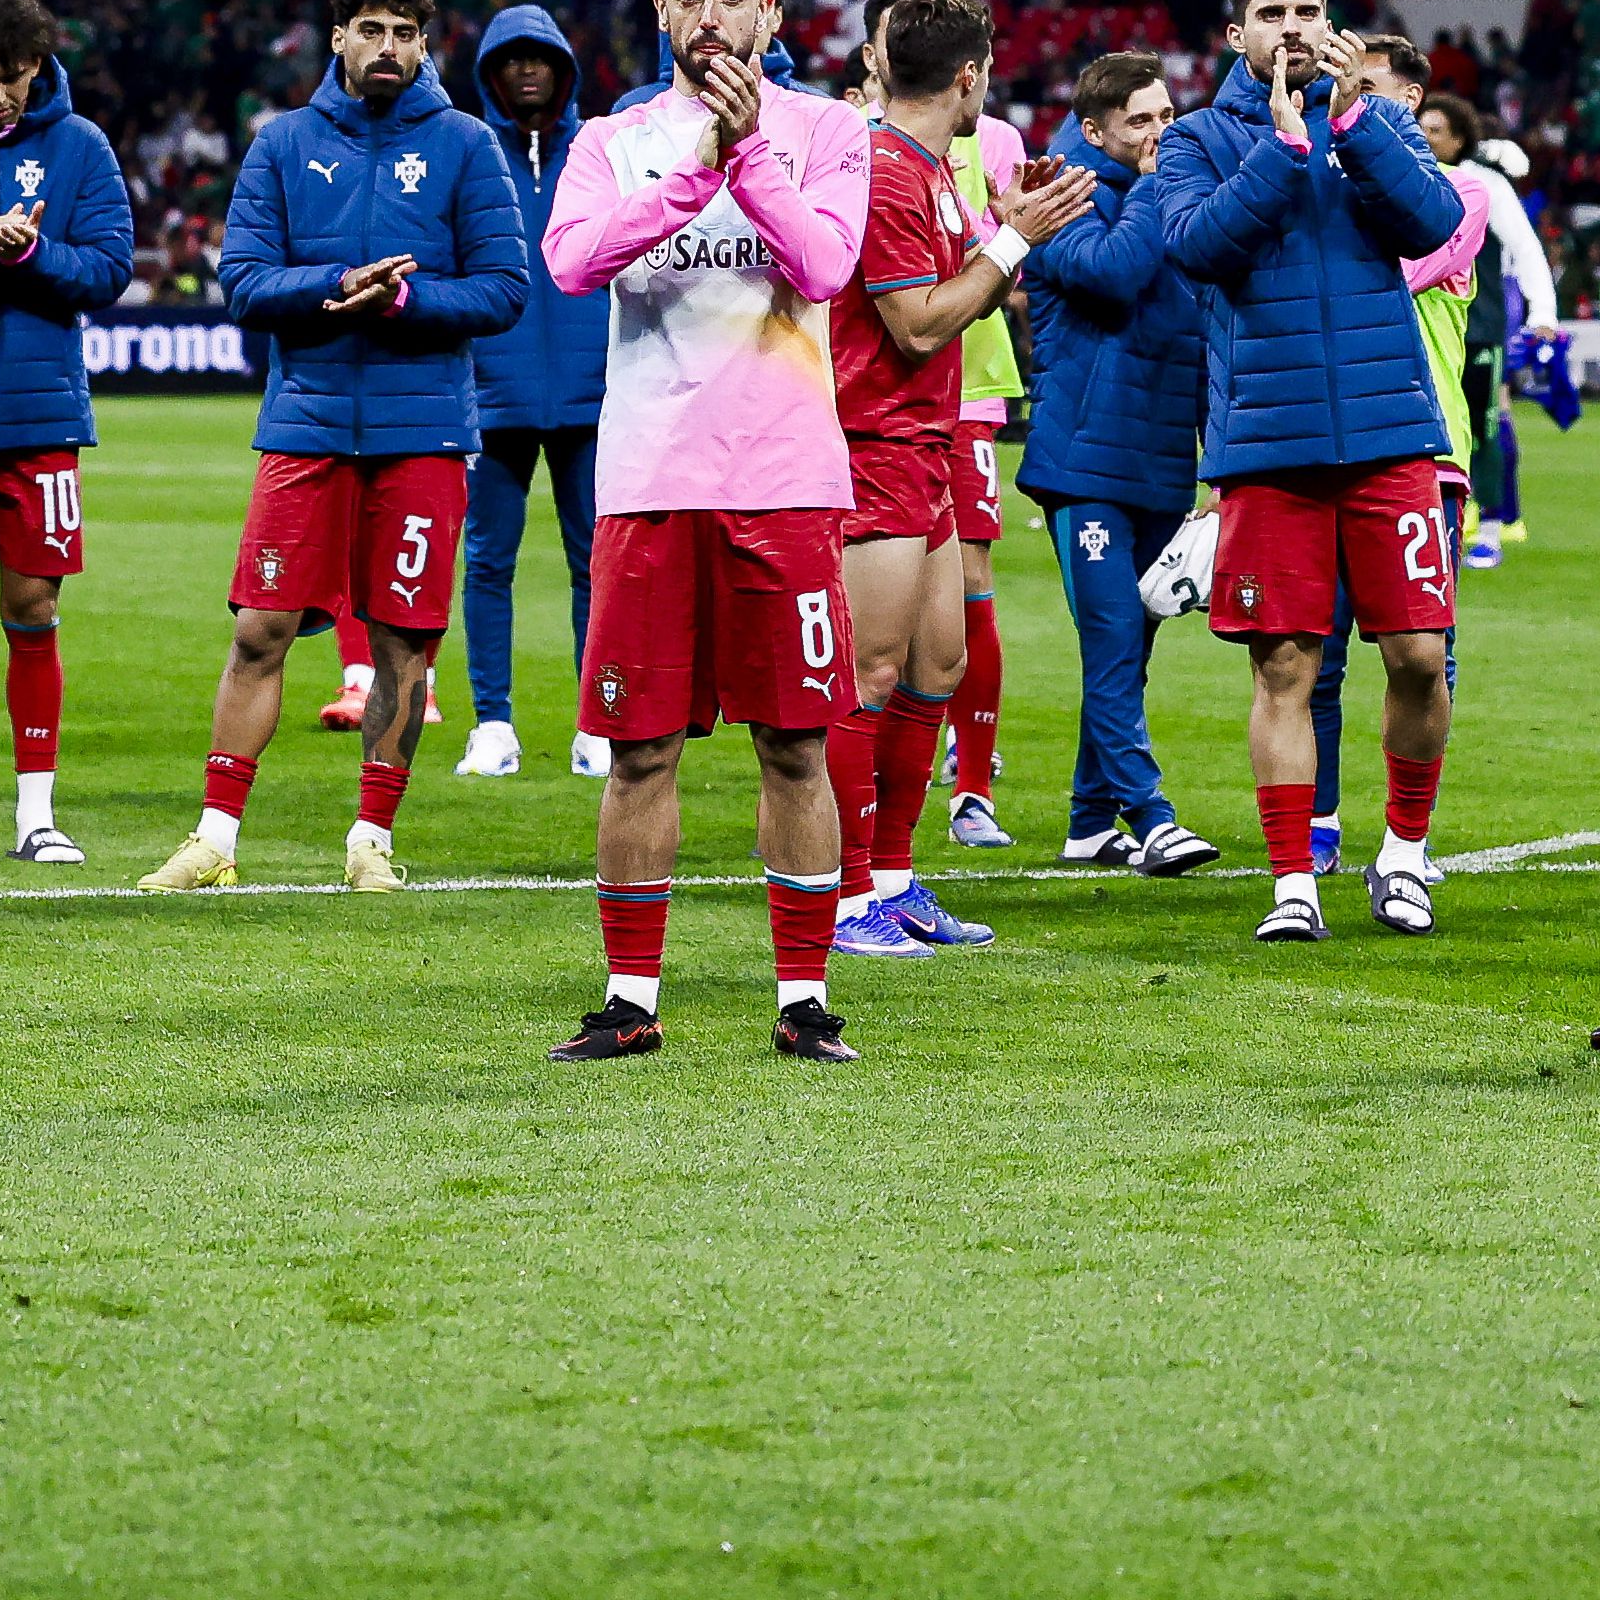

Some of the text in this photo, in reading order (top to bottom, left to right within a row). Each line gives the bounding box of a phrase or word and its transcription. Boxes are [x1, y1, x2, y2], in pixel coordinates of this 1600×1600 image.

[671, 233, 784, 272] SAGRE
[80, 317, 246, 375] orona
[36, 468, 81, 534] 10
[973, 439, 996, 498] 9
[397, 514, 433, 579] 5
[1397, 505, 1448, 582] 21
[795, 589, 837, 670] 8
